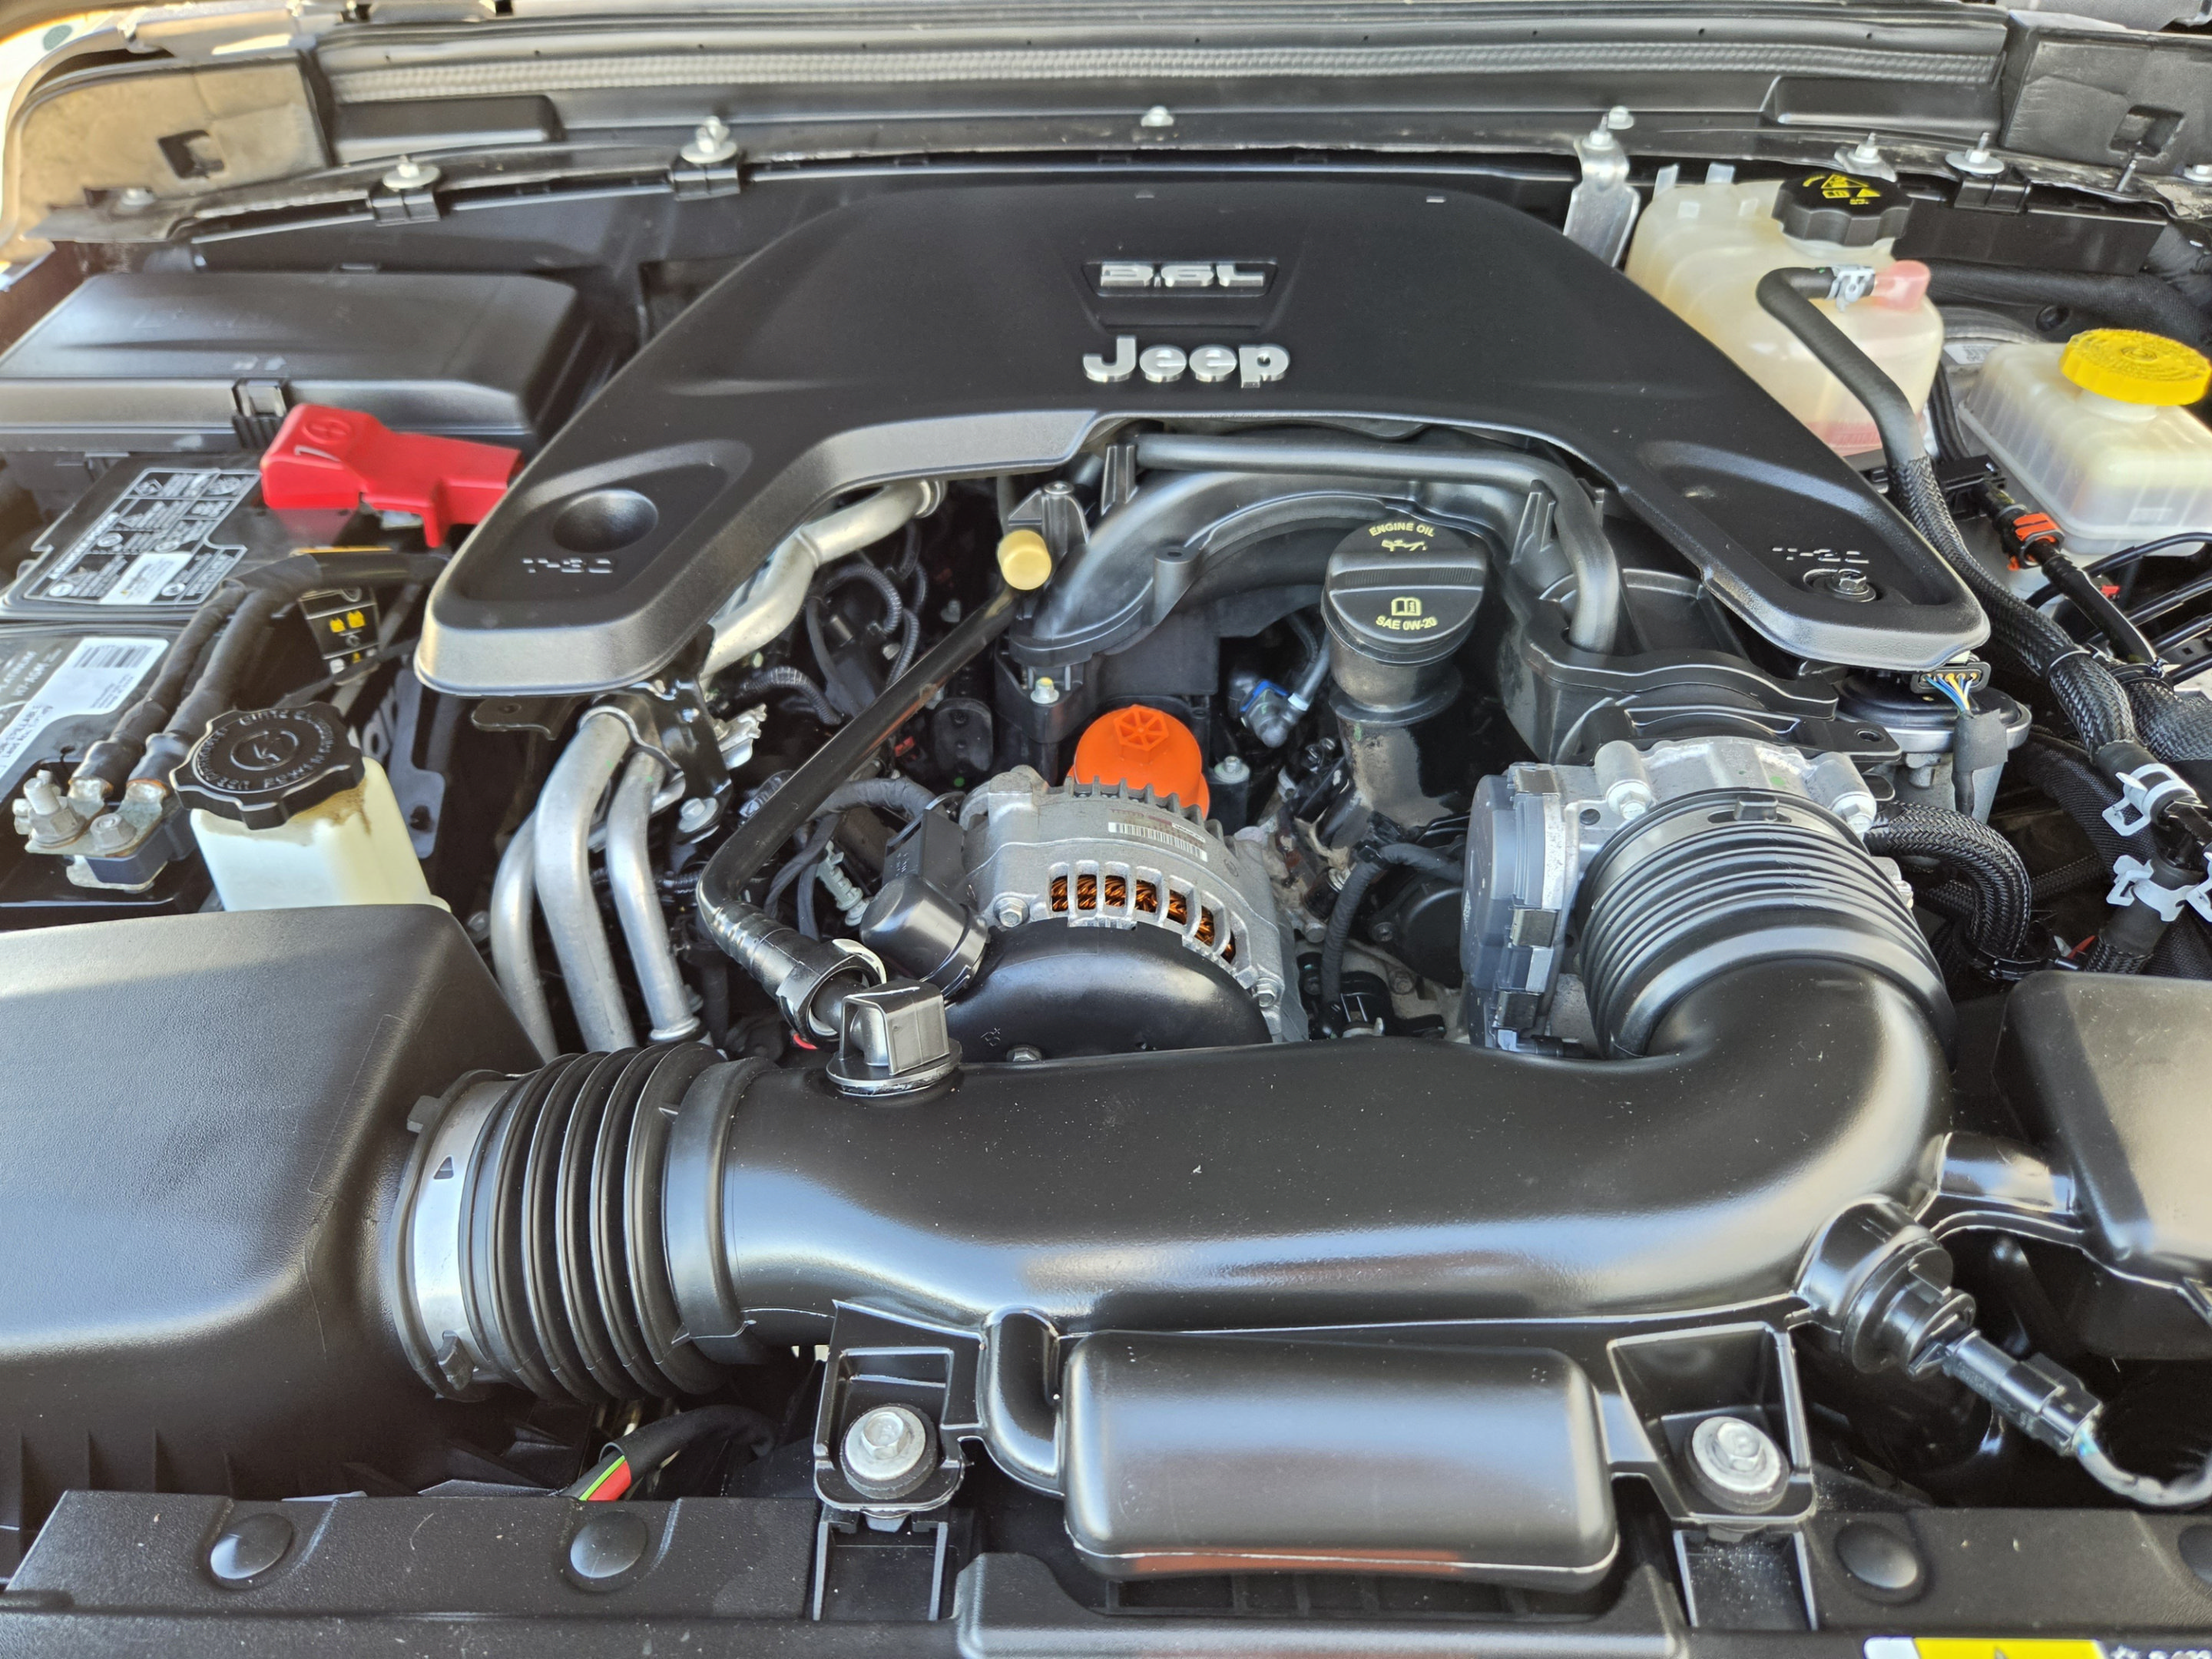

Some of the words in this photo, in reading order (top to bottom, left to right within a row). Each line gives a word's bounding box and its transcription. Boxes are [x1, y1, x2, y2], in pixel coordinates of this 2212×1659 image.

[1083, 336, 1290, 389] Jeep
[1369, 522, 1414, 537] ENGINE
[1416, 524, 1435, 537] OIL
[1376, 615, 1401, 630] SAE
[1402, 617, 1439, 631] 0W-20
